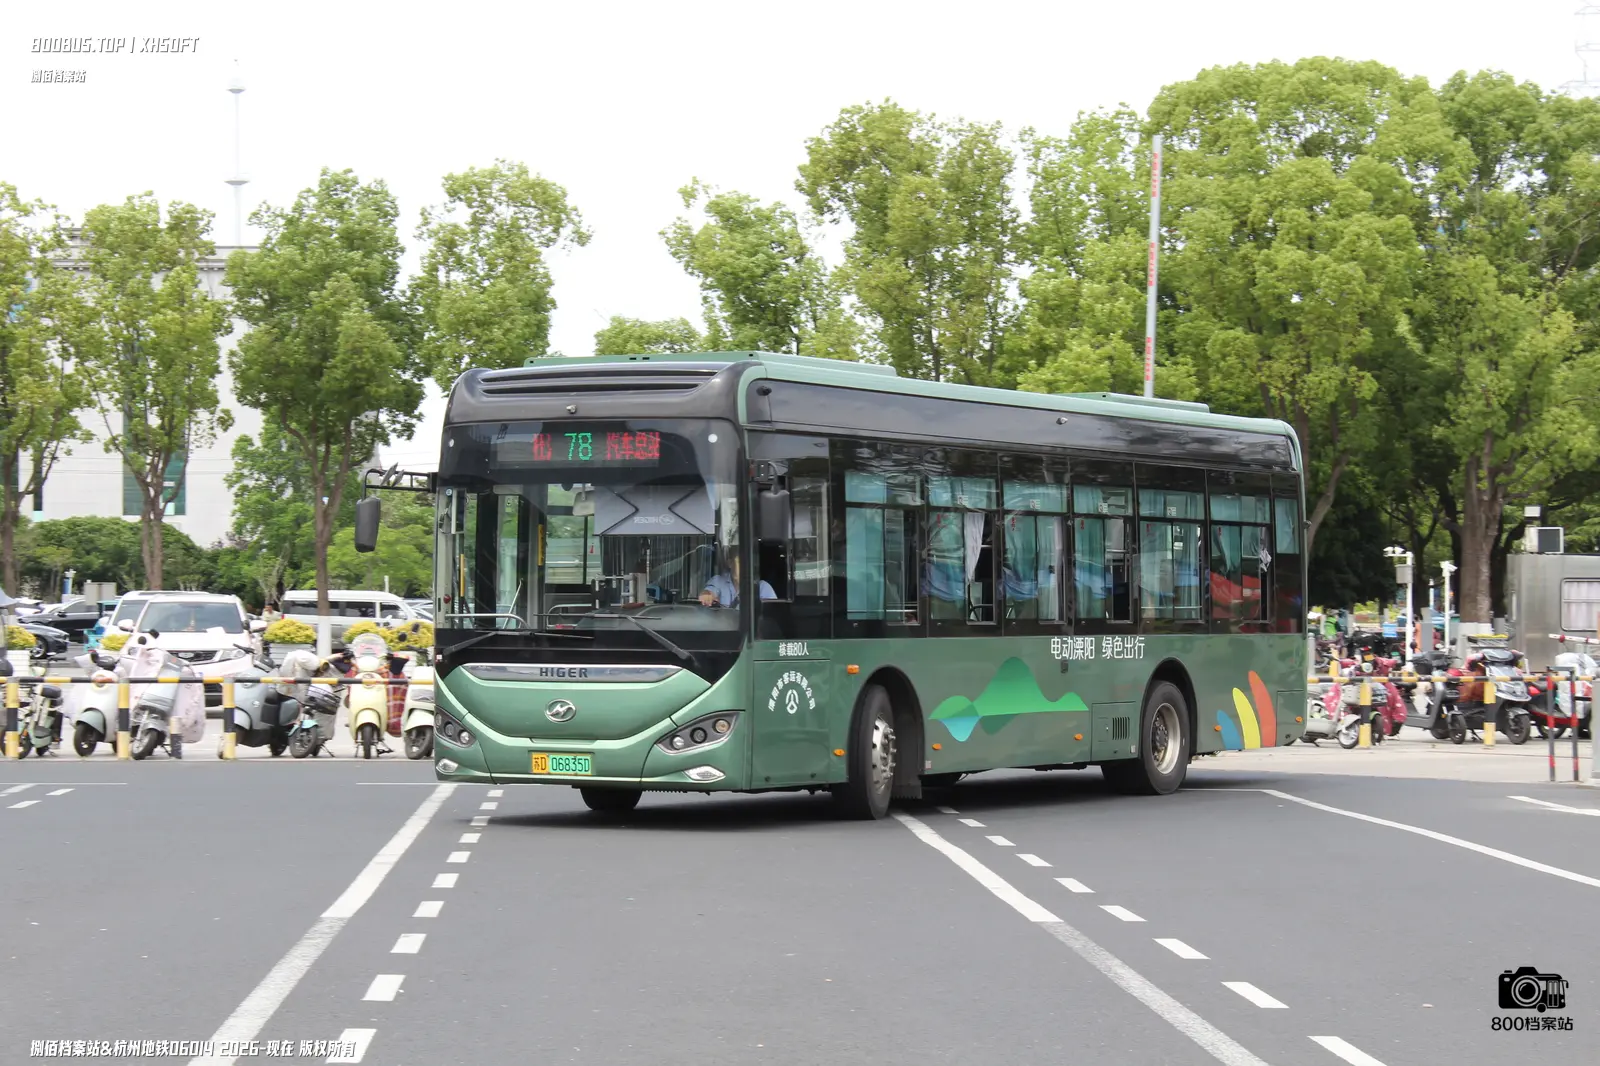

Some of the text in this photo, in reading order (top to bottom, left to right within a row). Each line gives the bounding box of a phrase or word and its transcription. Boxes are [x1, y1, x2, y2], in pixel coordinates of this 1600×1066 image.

[564, 432, 593, 461] 78
[779, 642, 810, 657] 核载80人
[1050, 635, 1146, 660] 电动溧阳 绿色出行
[540, 667, 589, 679] HIGER
